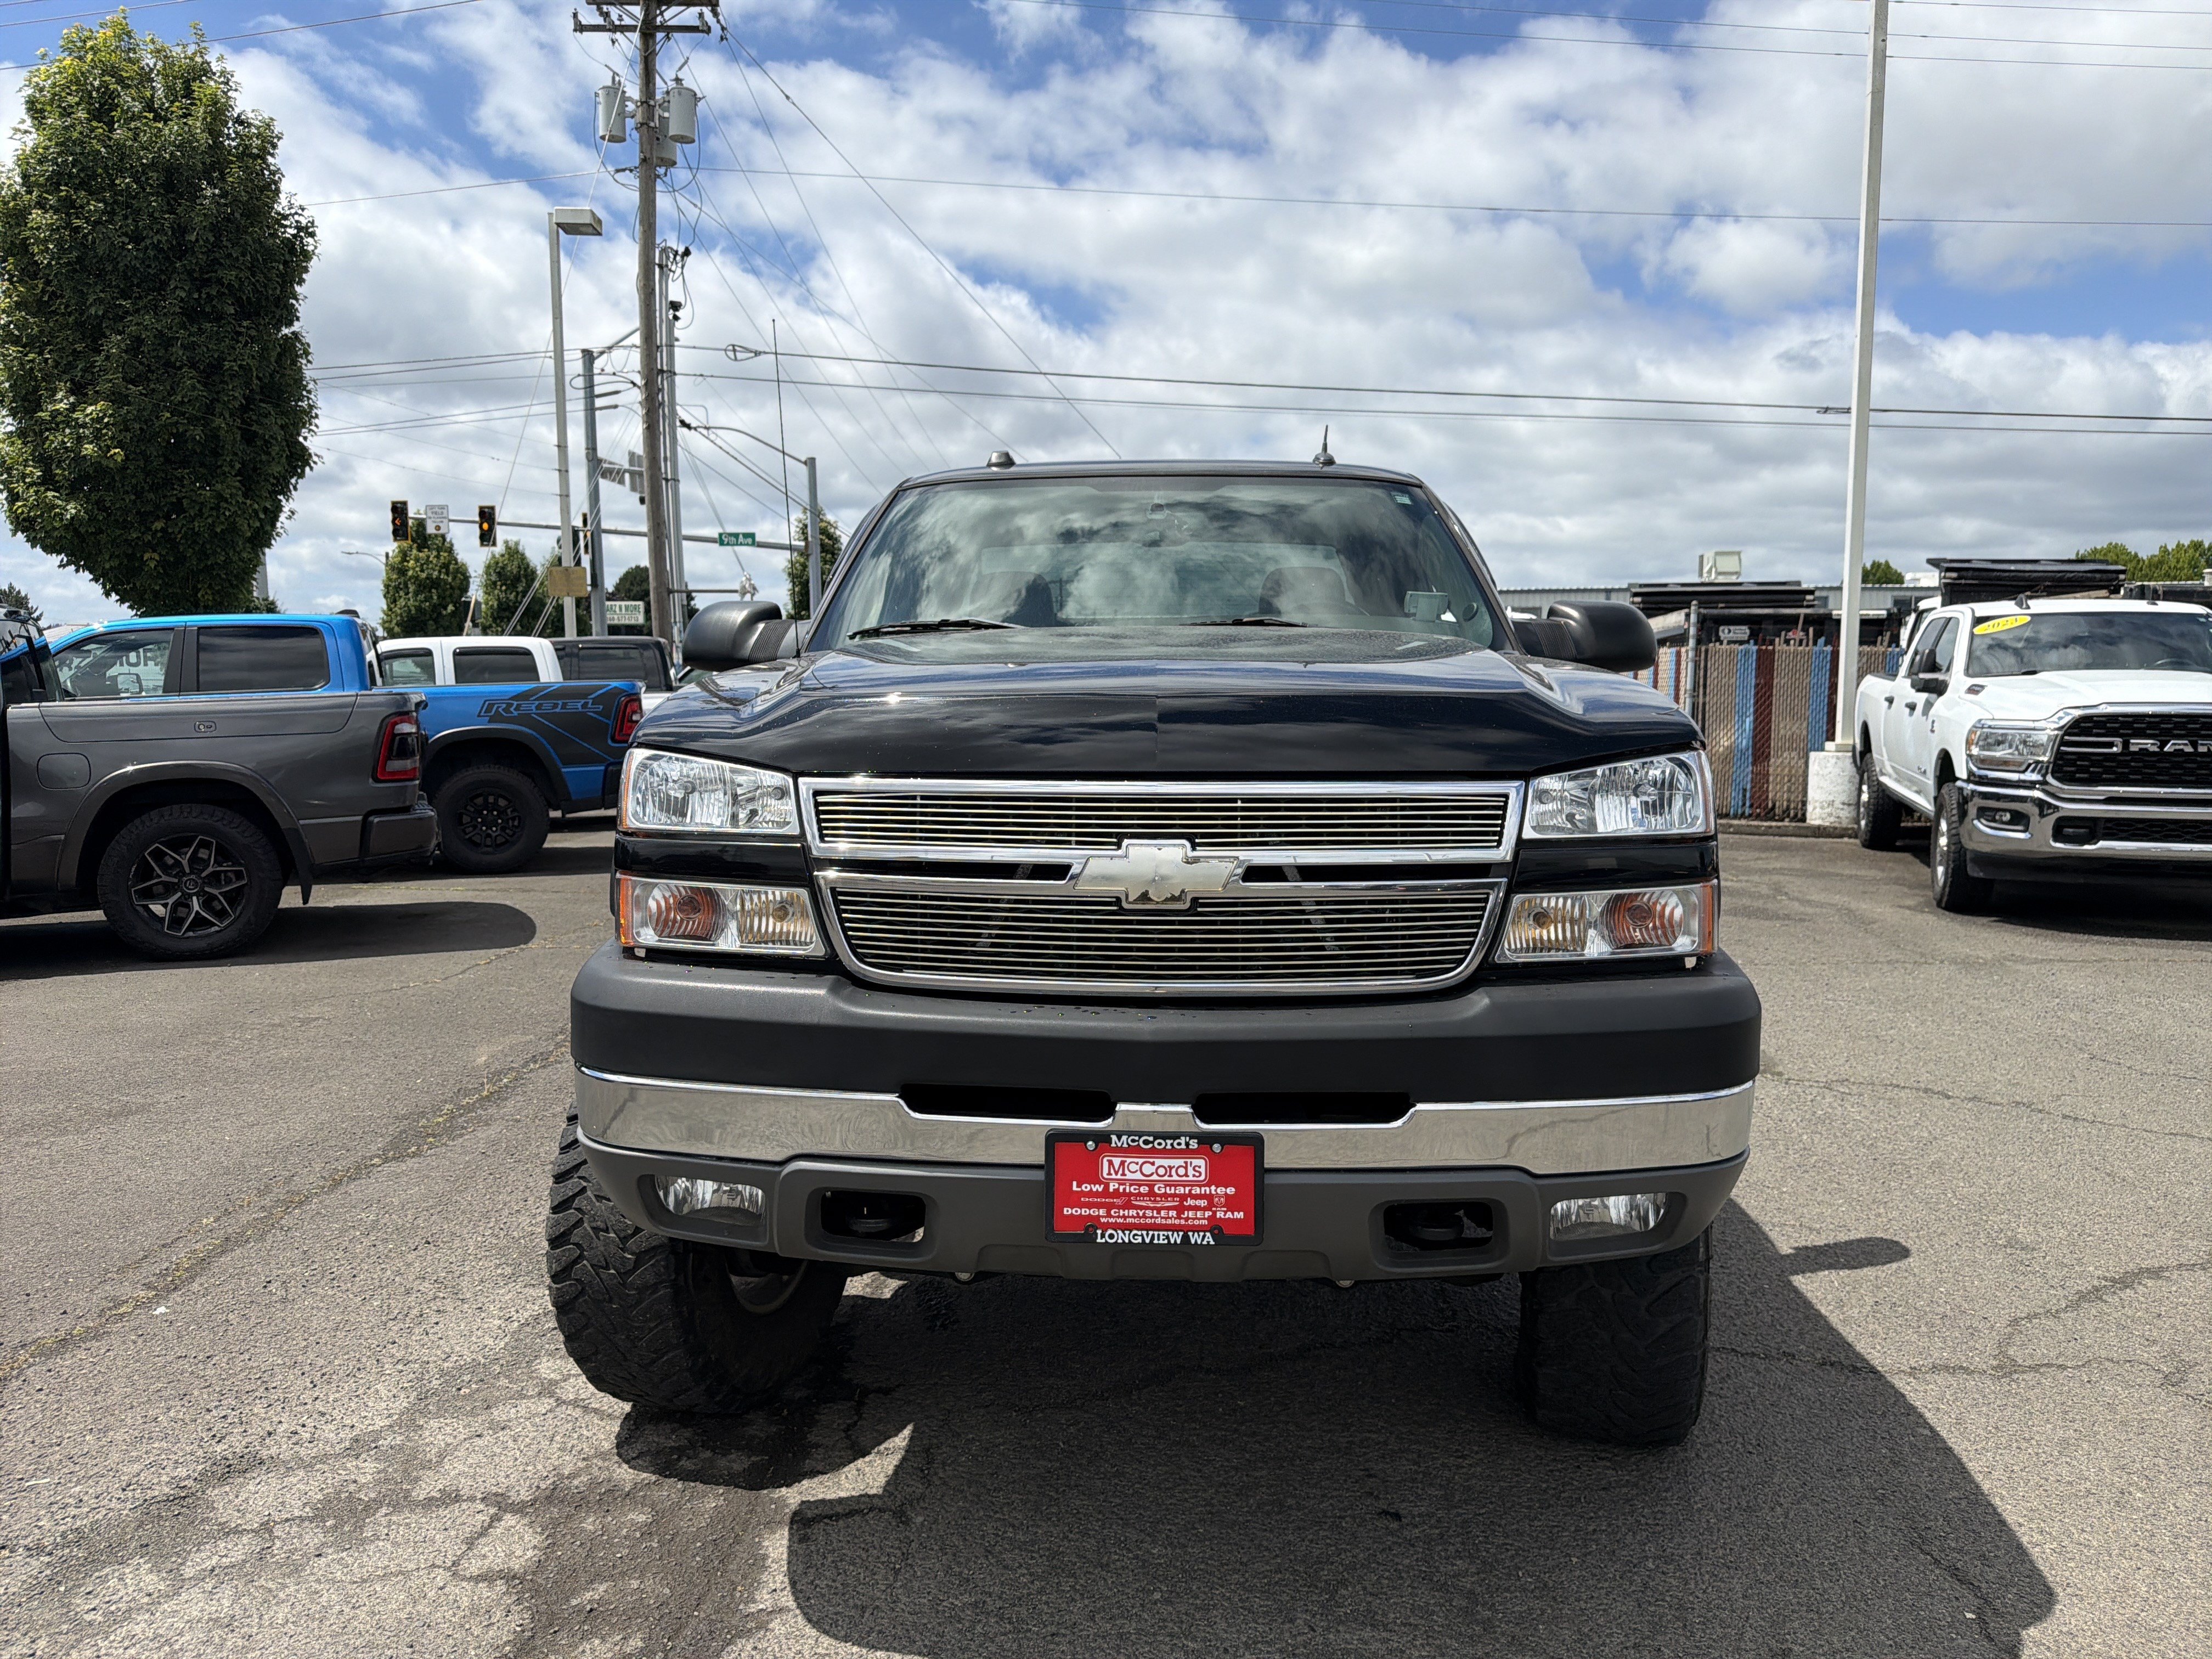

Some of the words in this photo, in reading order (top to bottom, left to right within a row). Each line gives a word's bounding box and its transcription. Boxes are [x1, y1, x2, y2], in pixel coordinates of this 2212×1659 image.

[721, 534, 737, 544] 9th
[737, 533, 753, 545] Ave
[624, 604, 641, 613] MORE
[478, 699, 603, 717] REBEL
[1110, 1135, 1199, 1149] McCord's
[1106, 1159, 1203, 1178] McCord's
[1072, 1181, 1104, 1192] Low
[1109, 1182, 1149, 1193] Price
[1154, 1183, 1236, 1195] Guarantee
[1183, 1197, 1208, 1207] Jeep
[1063, 1207, 1107, 1216] DODGE
[1110, 1209, 1177, 1217] CHRYSLER
[1099, 1217, 1208, 1225] www.mccordsales.com
[1096, 1230, 1184, 1244] LONGVIEW
[1187, 1232, 1215, 1245] WA
